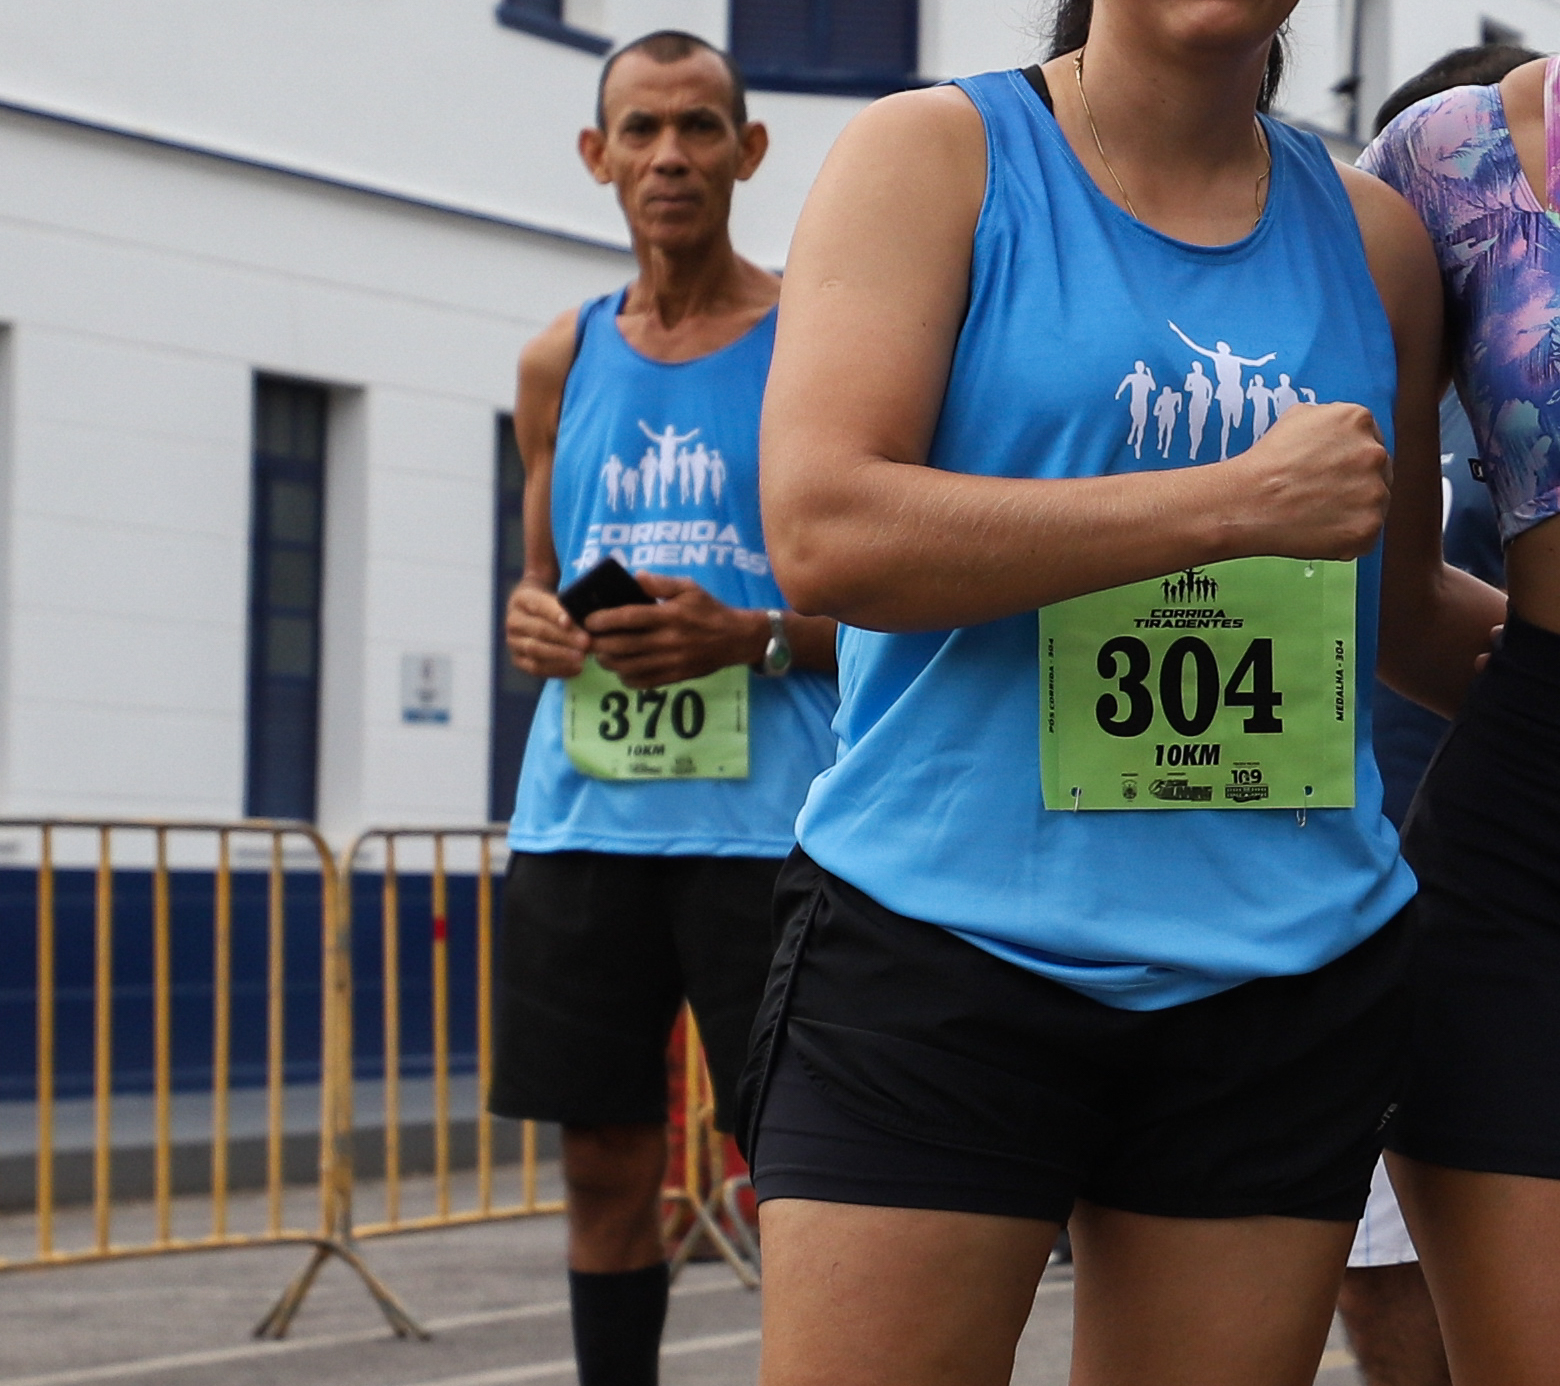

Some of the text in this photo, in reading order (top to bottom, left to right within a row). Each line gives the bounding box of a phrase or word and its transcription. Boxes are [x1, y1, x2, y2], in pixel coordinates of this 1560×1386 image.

[586, 520, 739, 546] CORRIDA
[1133, 618, 1244, 629] TIRADENTES
[1150, 608, 1227, 619] CORRIDA
[1048, 666, 1056, 710] CORRIDA
[1095, 635, 1284, 739] 304
[1335, 669, 1345, 721] MEDALHA
[598, 688, 706, 741] 370
[627, 744, 666, 757] 10KM
[1155, 743, 1221, 766] 10KM
